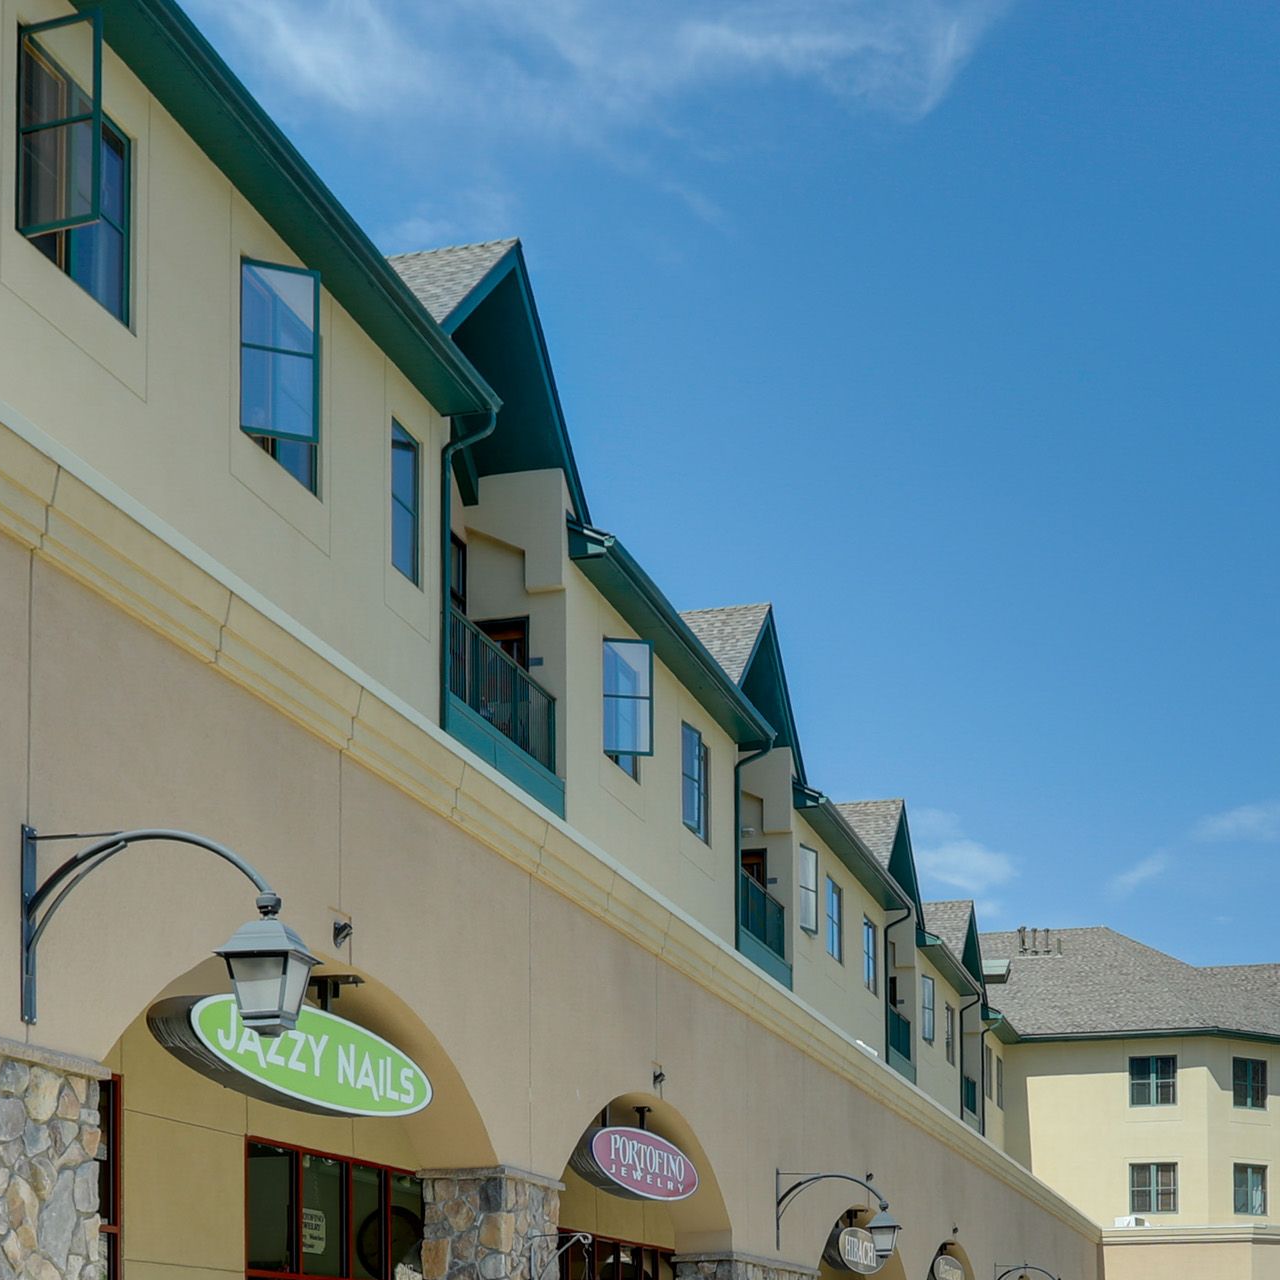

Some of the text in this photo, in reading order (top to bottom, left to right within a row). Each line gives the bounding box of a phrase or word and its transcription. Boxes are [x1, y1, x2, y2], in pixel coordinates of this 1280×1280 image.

[217, 1002, 415, 1105] JAZZY NAILS
[609, 1134, 685, 1182] PORTOFINO
[609, 1163, 684, 1193] JEWELRY
